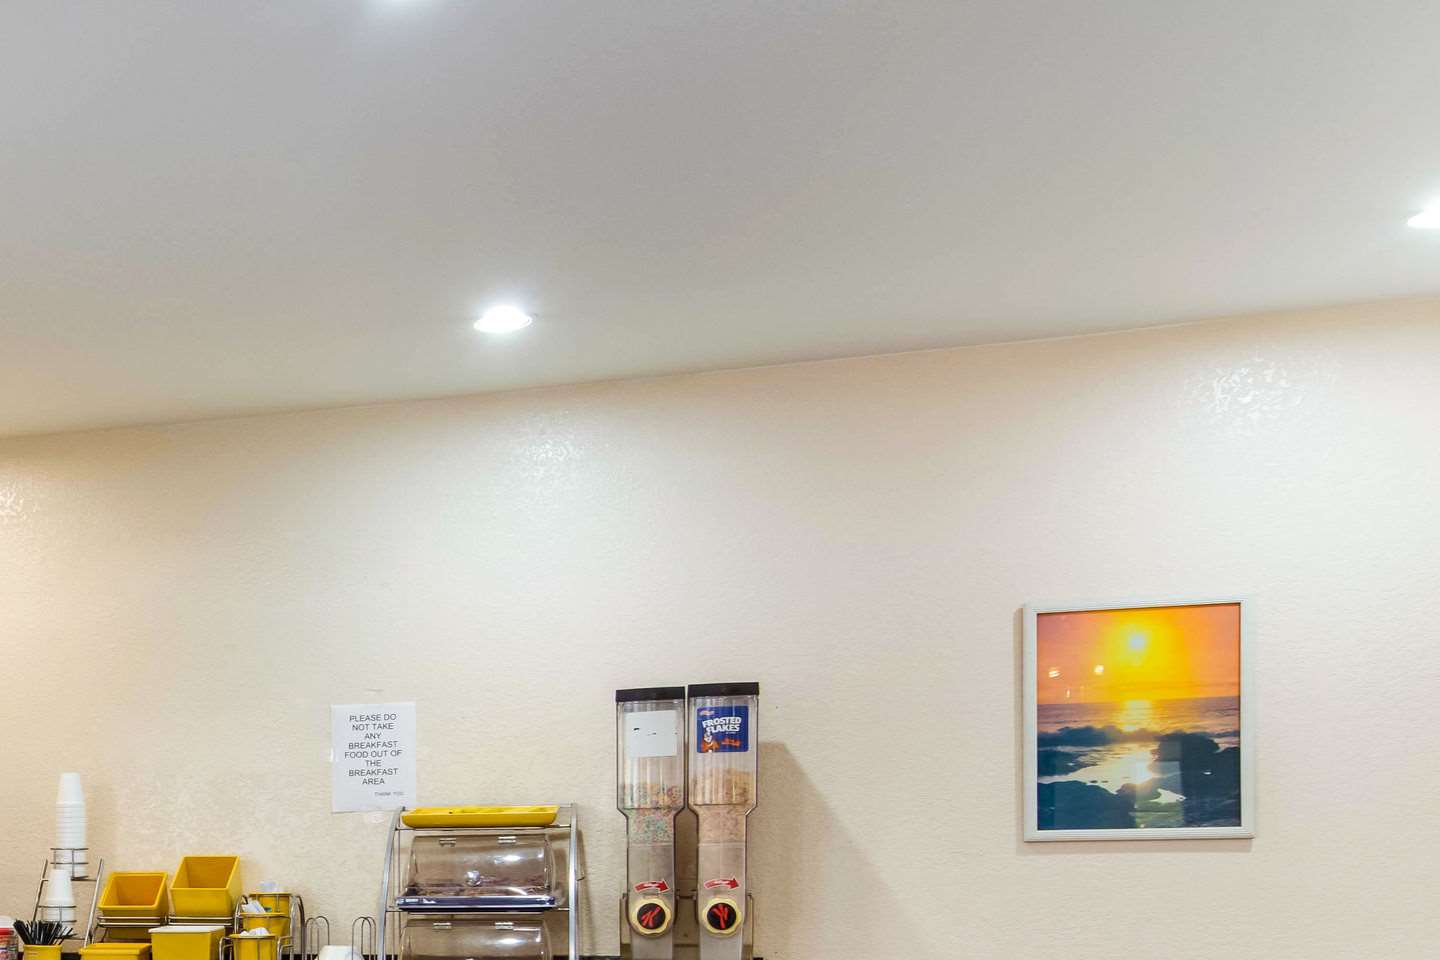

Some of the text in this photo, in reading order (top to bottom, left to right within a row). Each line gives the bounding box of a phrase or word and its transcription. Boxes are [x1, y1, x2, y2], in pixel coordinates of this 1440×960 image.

[349, 713, 397, 723] PLEASE DO
[702, 716, 742, 728] FROSTED
[352, 722, 395, 731] NOT TAKE
[705, 724, 740, 733] FLAKES
[364, 732, 382, 740] ANY
[348, 741, 399, 750] BREAKFAST
[344, 749, 403, 759] FOOD OUT OF
[365, 759, 382, 767] THE
[348, 768, 399, 777] BREAKFAST
[362, 777, 385, 785] AREA
